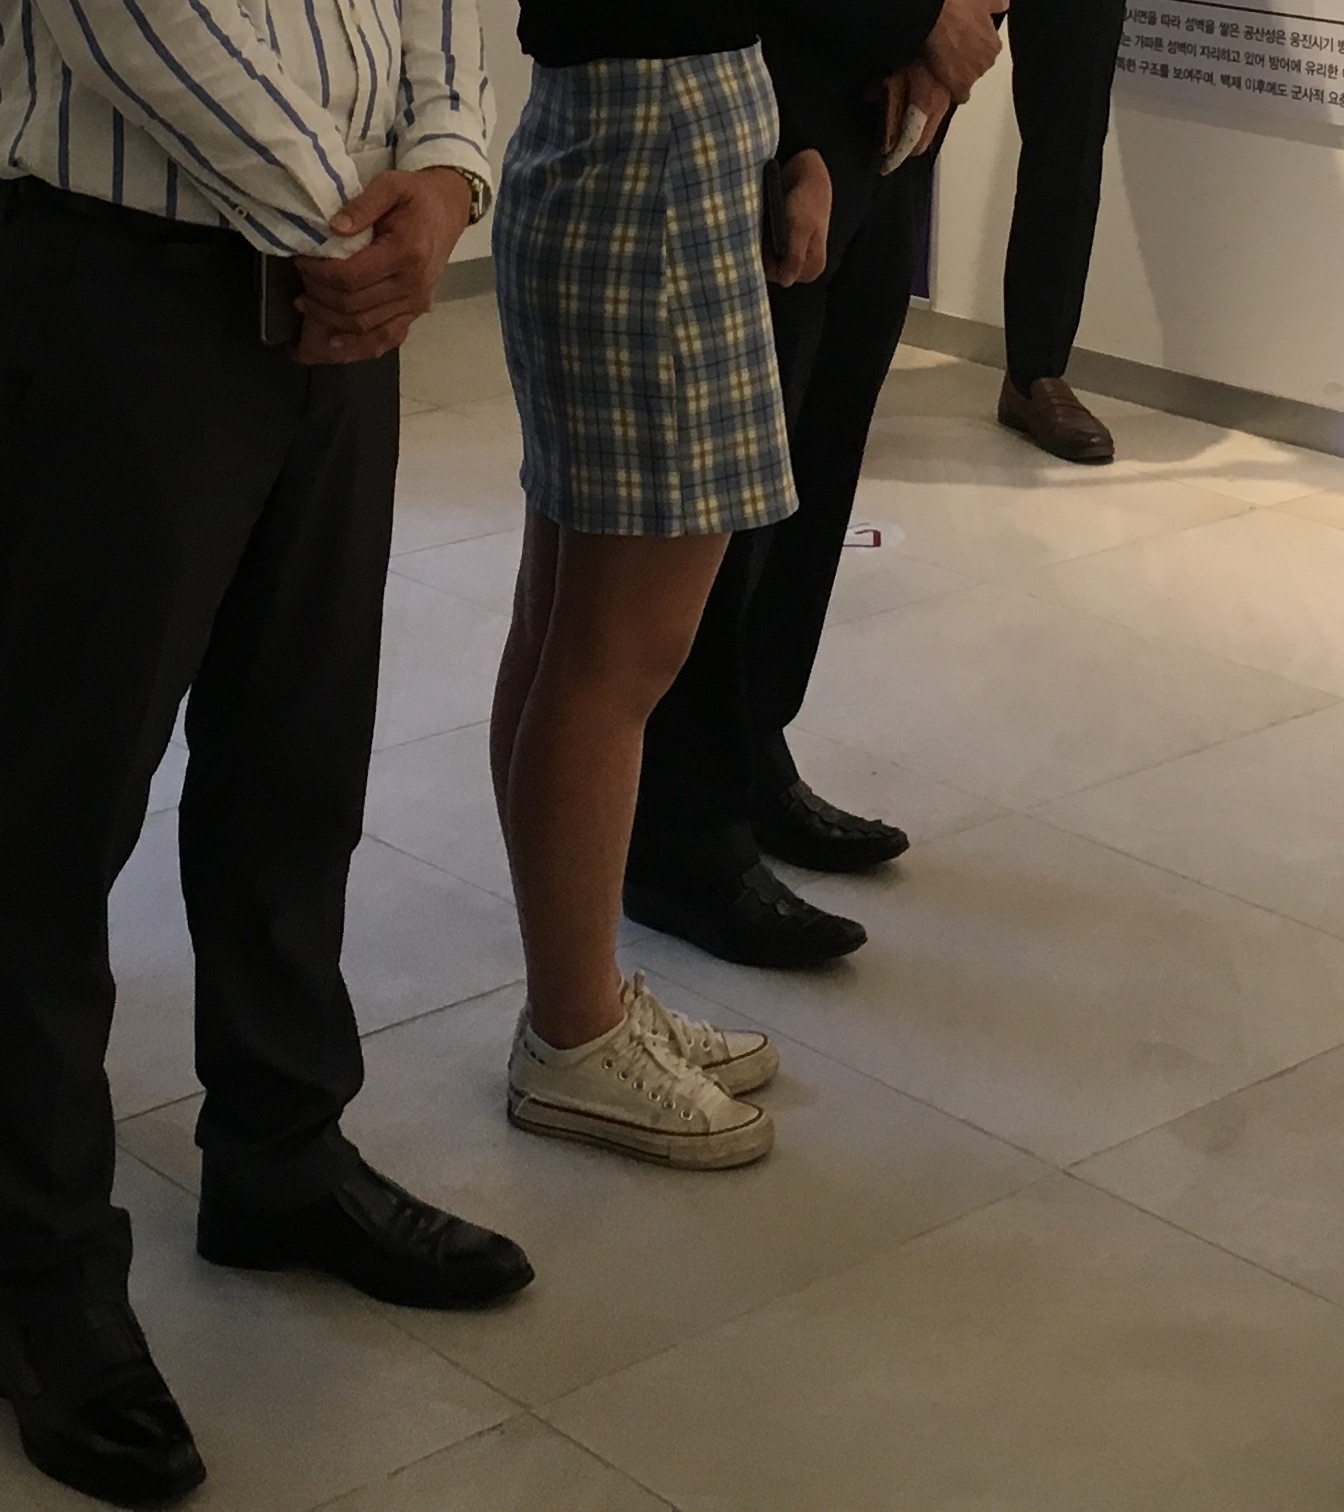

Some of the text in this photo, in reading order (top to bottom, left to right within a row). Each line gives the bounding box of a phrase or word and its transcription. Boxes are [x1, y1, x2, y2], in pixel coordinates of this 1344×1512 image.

[1124, 7, 1157, 26] 사면을
[1160, 14, 1181, 29] 따라
[1184, 17, 1215, 34] 성벽을
[1243, 25, 1287, 46] 공산성은
[1289, 32, 1334, 52] 웅진시기
[1167, 40, 1197, 57] 성벽이
[1199, 45, 1240, 63] 자리하고
[1243, 52, 1265, 68] 있어
[1268, 55, 1302, 73] 방어에
[1304, 61, 1338, 79] 유리한
[1290, 85, 1324, 104] 군사적
